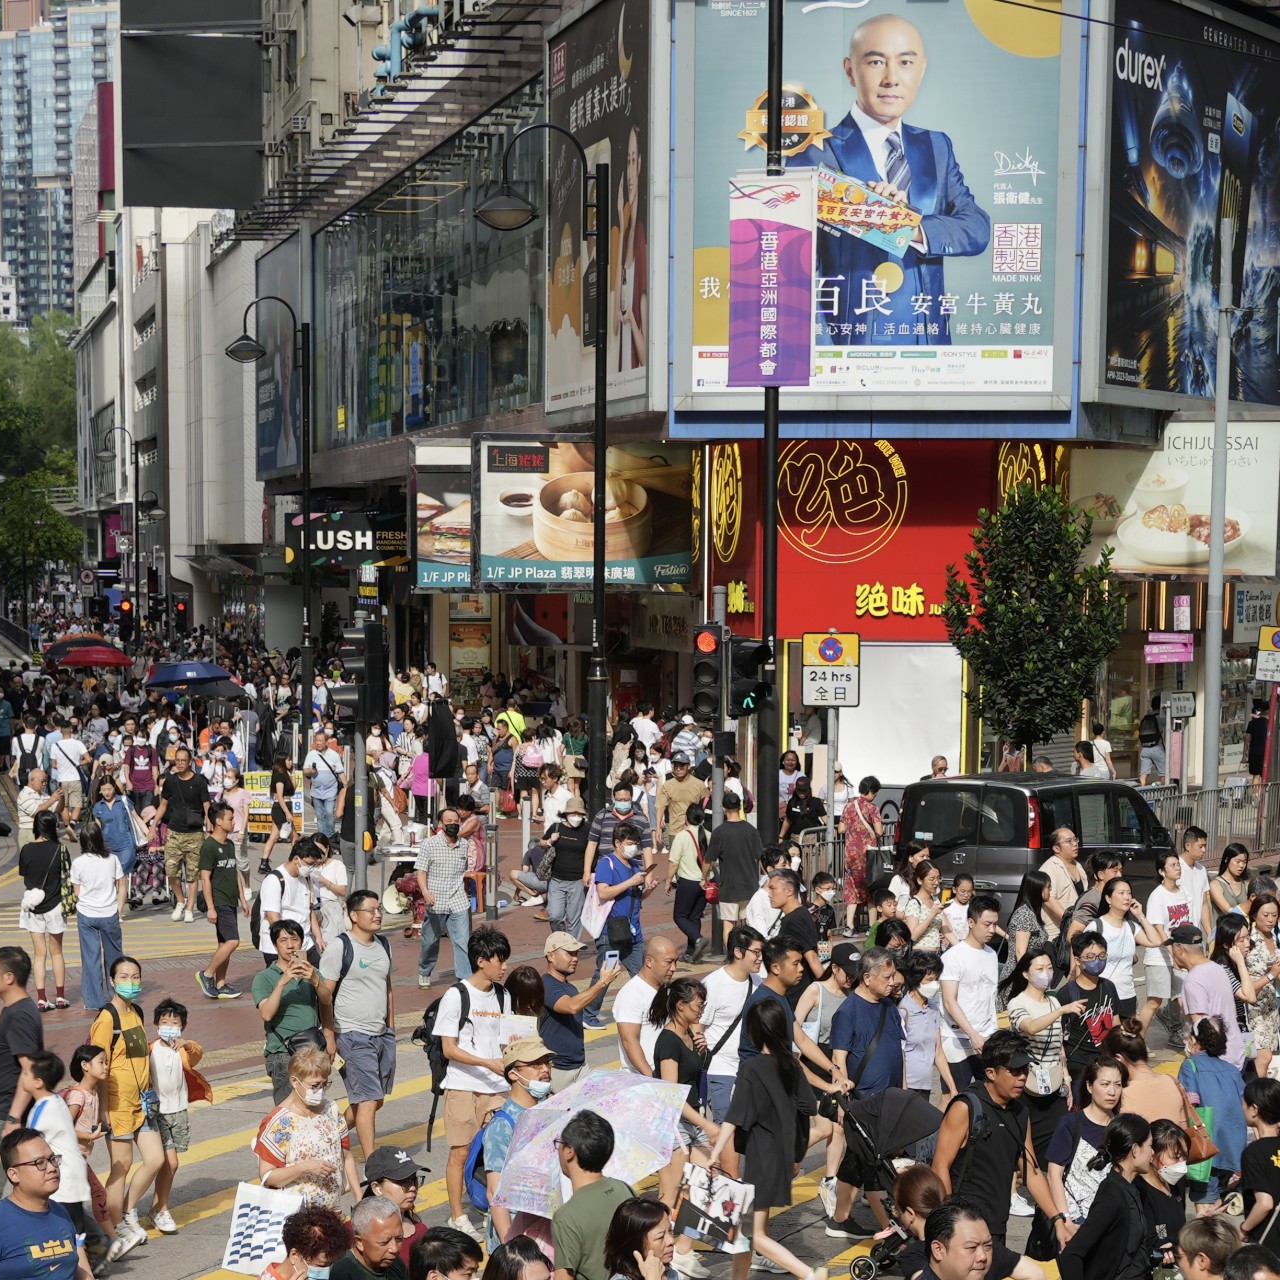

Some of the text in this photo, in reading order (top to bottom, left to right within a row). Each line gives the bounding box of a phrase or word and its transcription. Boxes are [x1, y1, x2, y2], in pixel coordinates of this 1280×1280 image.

[1203, 26, 1247, 53] GENERATED
[1115, 37, 1166, 92] durex
[994, 225, 1040, 247] 香港
[994, 249, 1040, 272] 製造
[992, 275, 1042, 283] MADE IN HK
[759, 231, 779, 376] 香港亞洲國際都會
[816, 274, 1043, 317] 百良 安宮牛黃丸
[883, 322, 940, 336] 活血通絡
[956, 322, 1042, 336] 維持心臟健康
[1167, 436, 1259, 451] ICHIJUSSAI
[491, 453, 545, 467] 上海姥姥
[874, 439, 907, 478] JUE WEI
[376, 531, 407, 539] FRESH
[422, 570, 471, 583] 1/F JP Pla
[486, 566, 505, 579] 1/F
[508, 566, 522, 578] JP
[525, 566, 557, 579] Plaza
[855, 580, 926, 617] 绝味
[810, 670, 852, 682] 24 hrs
[813, 686, 847, 702] 全日
